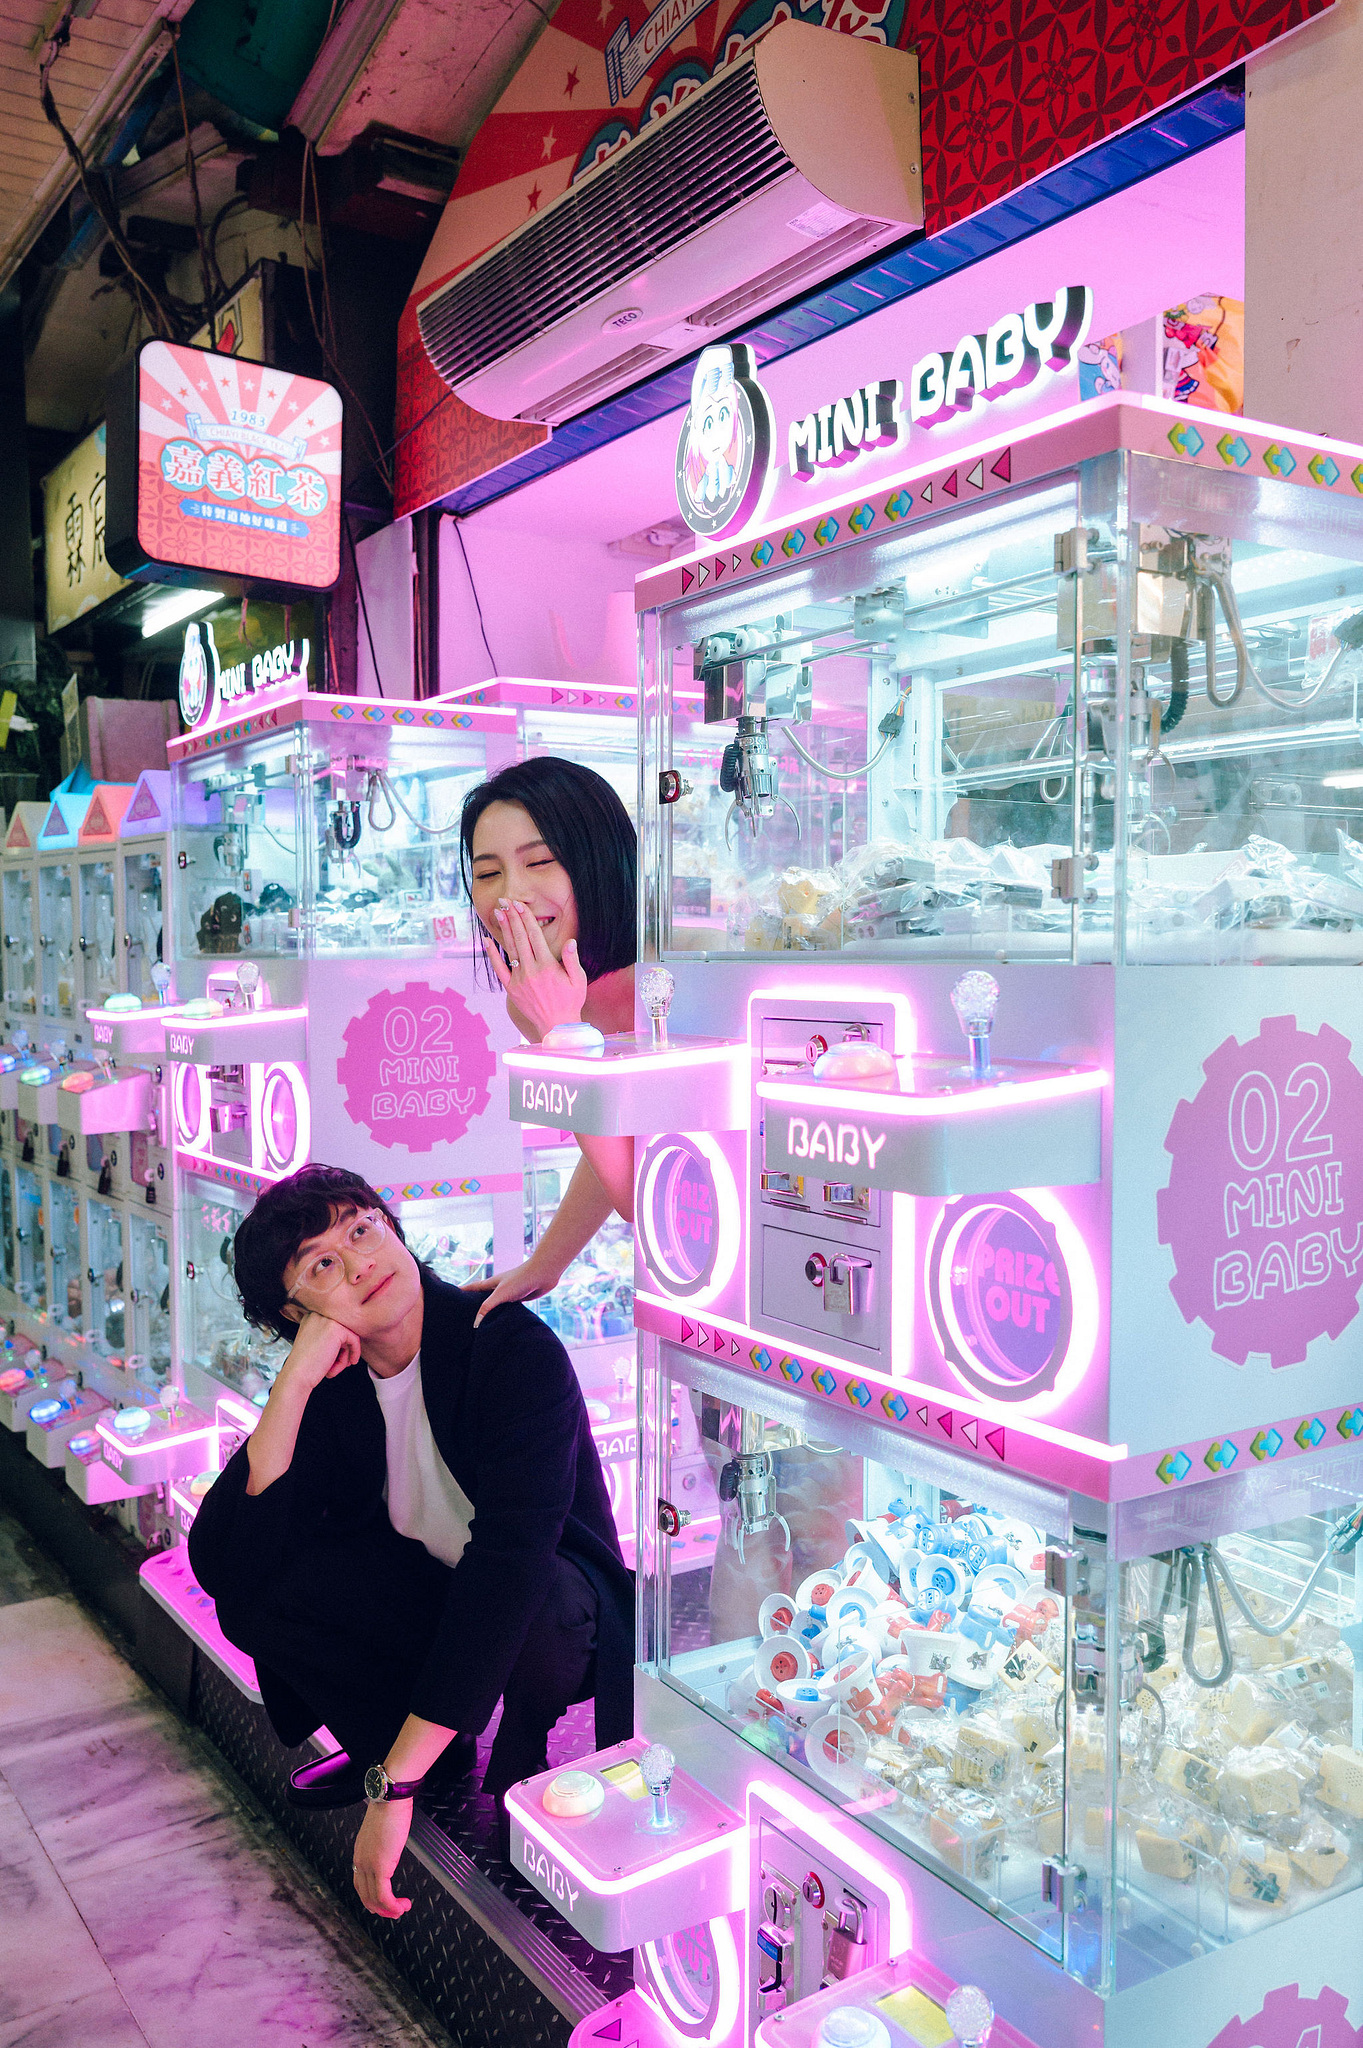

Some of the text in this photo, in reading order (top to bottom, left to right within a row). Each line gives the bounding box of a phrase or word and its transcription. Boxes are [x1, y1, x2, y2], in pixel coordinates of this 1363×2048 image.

[612, 312, 638, 328] TECO
[788, 285, 1087, 483] MINI BABY
[209, 427, 239, 439] CHIAYI
[231, 410, 266, 427] 1983
[165, 445, 325, 511] 嘉義紅茶
[251, 639, 297, 689] BABY
[93, 1024, 114, 1044] BABY
[169, 1033, 195, 1056] BABY
[383, 1004, 454, 1056] 02
[379, 1055, 460, 1087] MINI
[371, 1087, 477, 1121] BABY
[521, 1079, 579, 1117] BABY
[1228, 1062, 1334, 1172] 02
[787, 1116, 888, 1170] BABY
[673, 1179, 712, 1213] RIZ
[1223, 1161, 1345, 1239] MINI
[676, 1209, 713, 1245] OUT
[1213, 1221, 1363, 1311] BABY
[985, 1286, 1051, 1334] OUT
[103, 1441, 124, 1472] BABY
[596, 1433, 637, 1458] BAB
[523, 1835, 580, 1912] BABY
